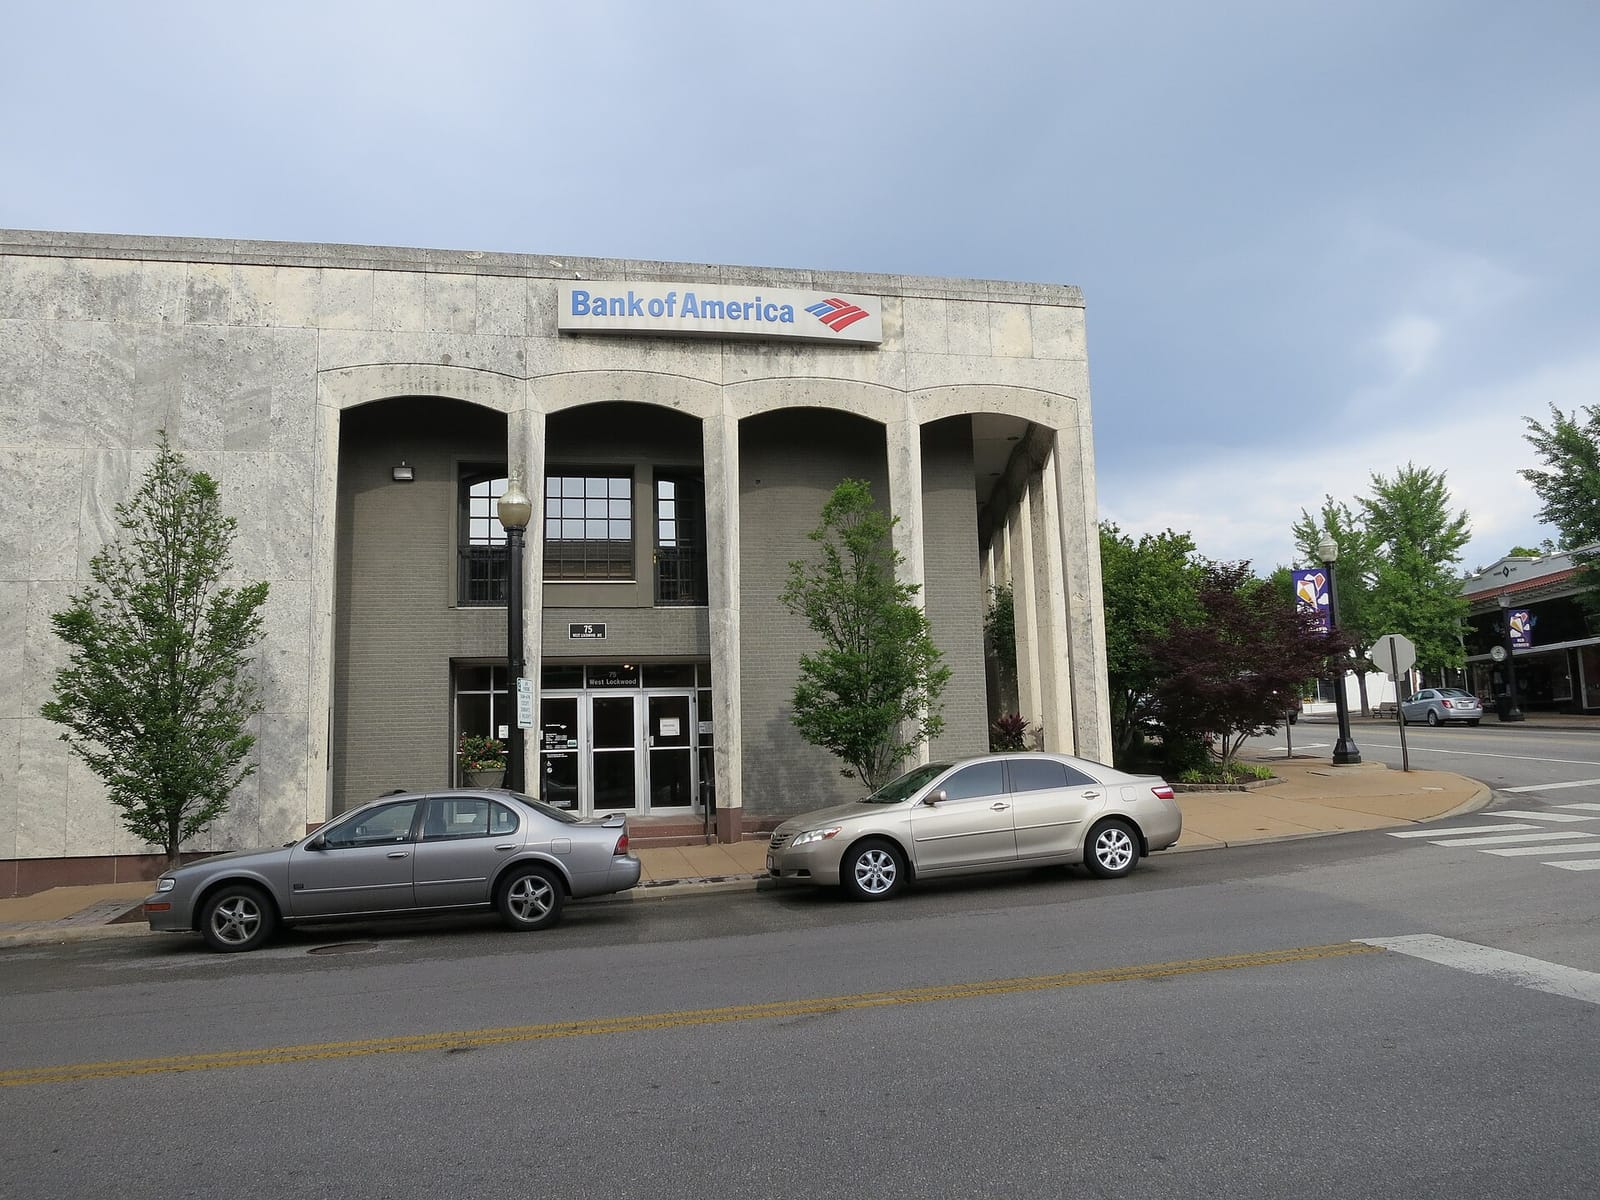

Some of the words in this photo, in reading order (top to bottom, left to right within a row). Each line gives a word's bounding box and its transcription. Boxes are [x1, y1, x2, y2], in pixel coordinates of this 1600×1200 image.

[571, 290, 644, 316] Bank
[648, 292, 677, 318] of
[680, 293, 794, 323] America
[584, 624, 593, 634] 75
[606, 677, 637, 685] Lockwood
